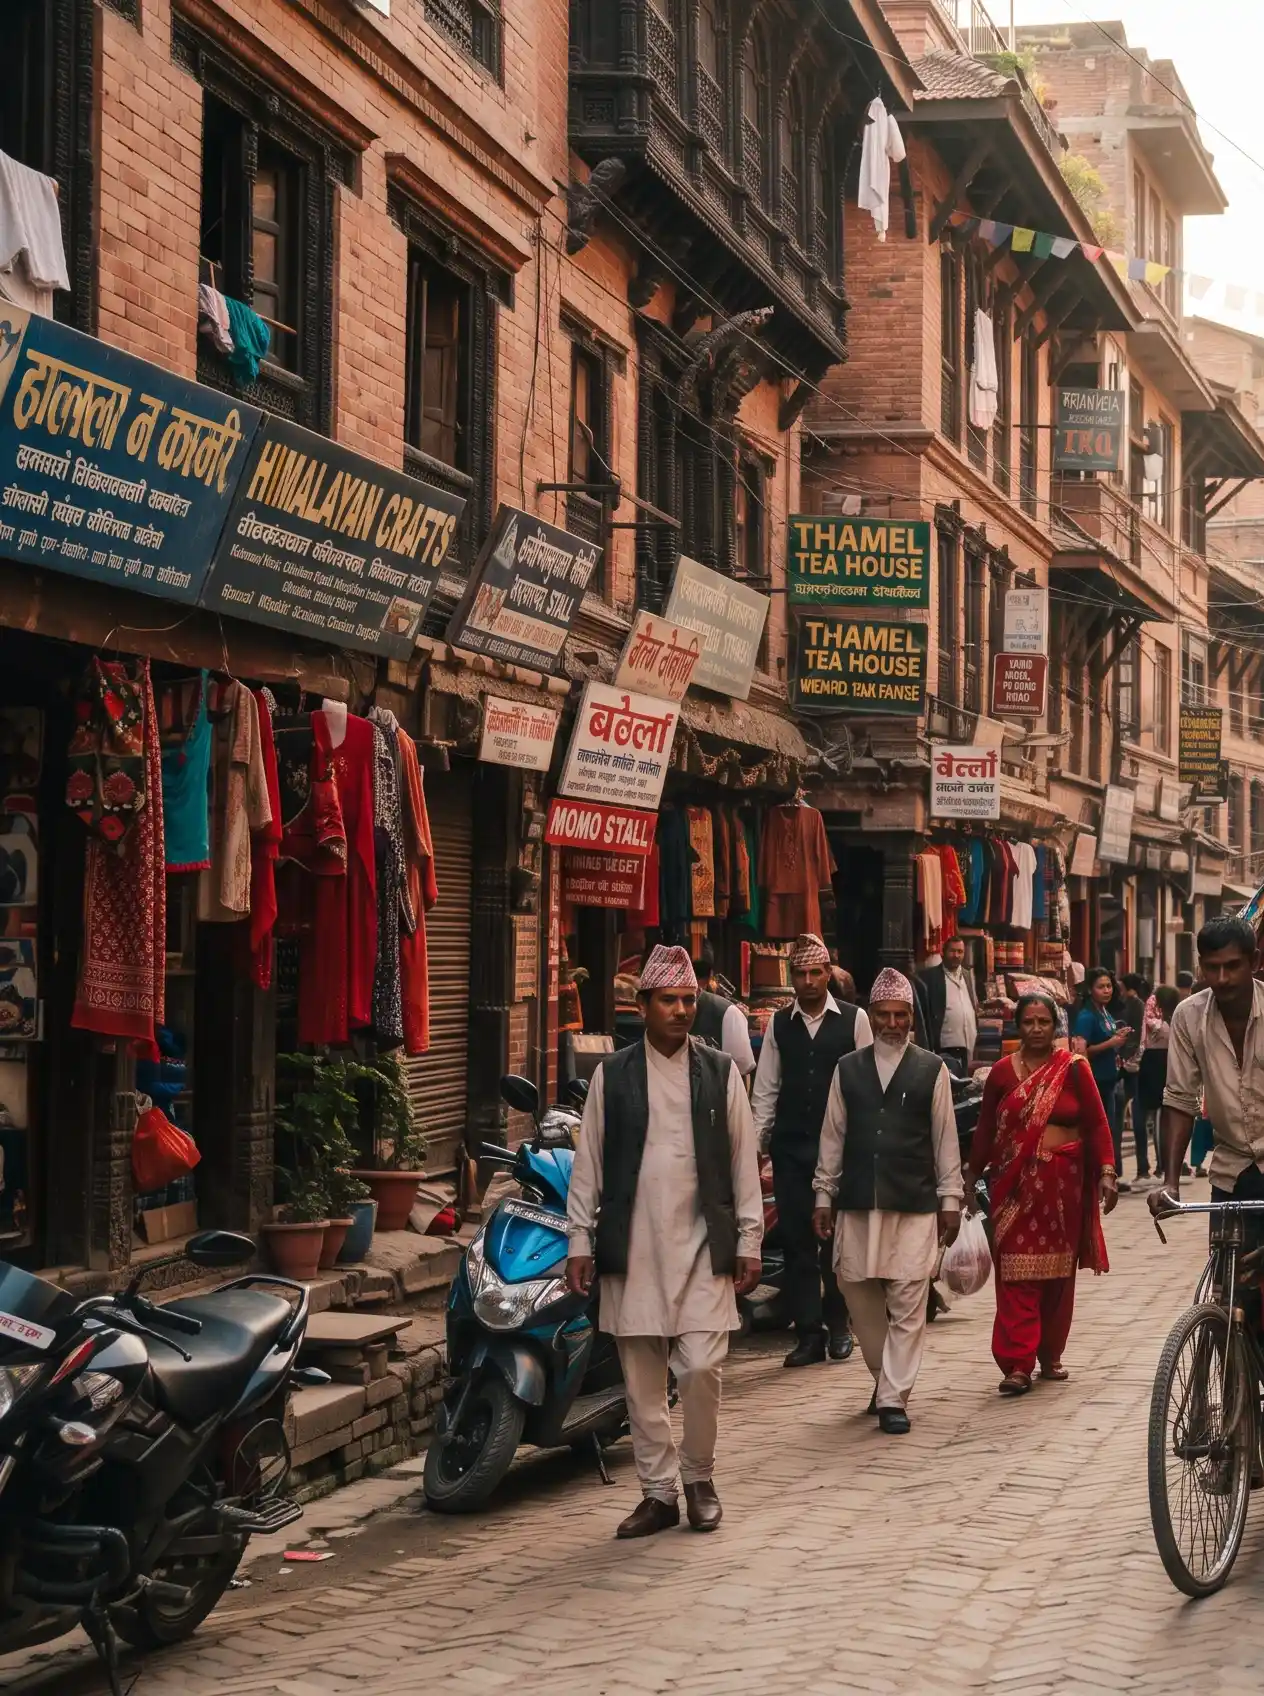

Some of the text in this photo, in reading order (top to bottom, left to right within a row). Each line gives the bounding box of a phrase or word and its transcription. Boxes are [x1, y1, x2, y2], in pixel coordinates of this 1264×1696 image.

[246, 440, 384, 541] HIMALAYAN
[375, 493, 457, 567] CRAFTS
[794, 522, 924, 555] THAMEL
[795, 552, 923, 579] TEA HOUSE
[805, 621, 921, 653] THAMEL
[804, 650, 920, 678] TEA HOUSE
[550, 806, 648, 848] MOMO STALL
